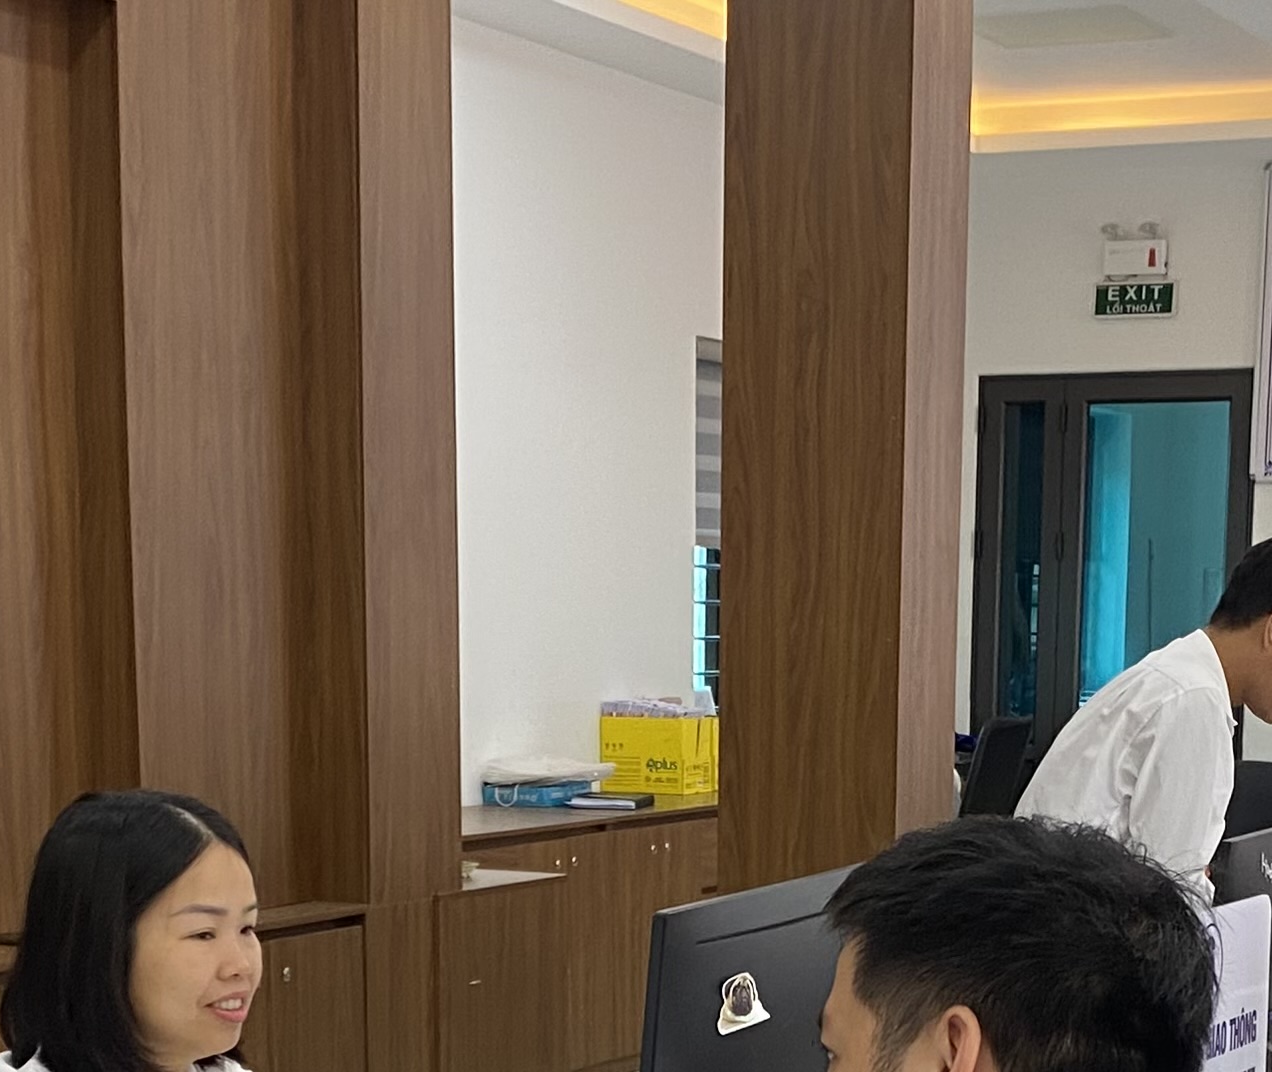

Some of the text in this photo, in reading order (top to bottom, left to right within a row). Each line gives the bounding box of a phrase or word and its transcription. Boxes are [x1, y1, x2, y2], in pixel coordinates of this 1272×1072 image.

[1108, 285, 1163, 301] EXIT
[1125, 301, 1162, 313] THOÁT
[1207, 1007, 1257, 1060] IAO THÔNG
